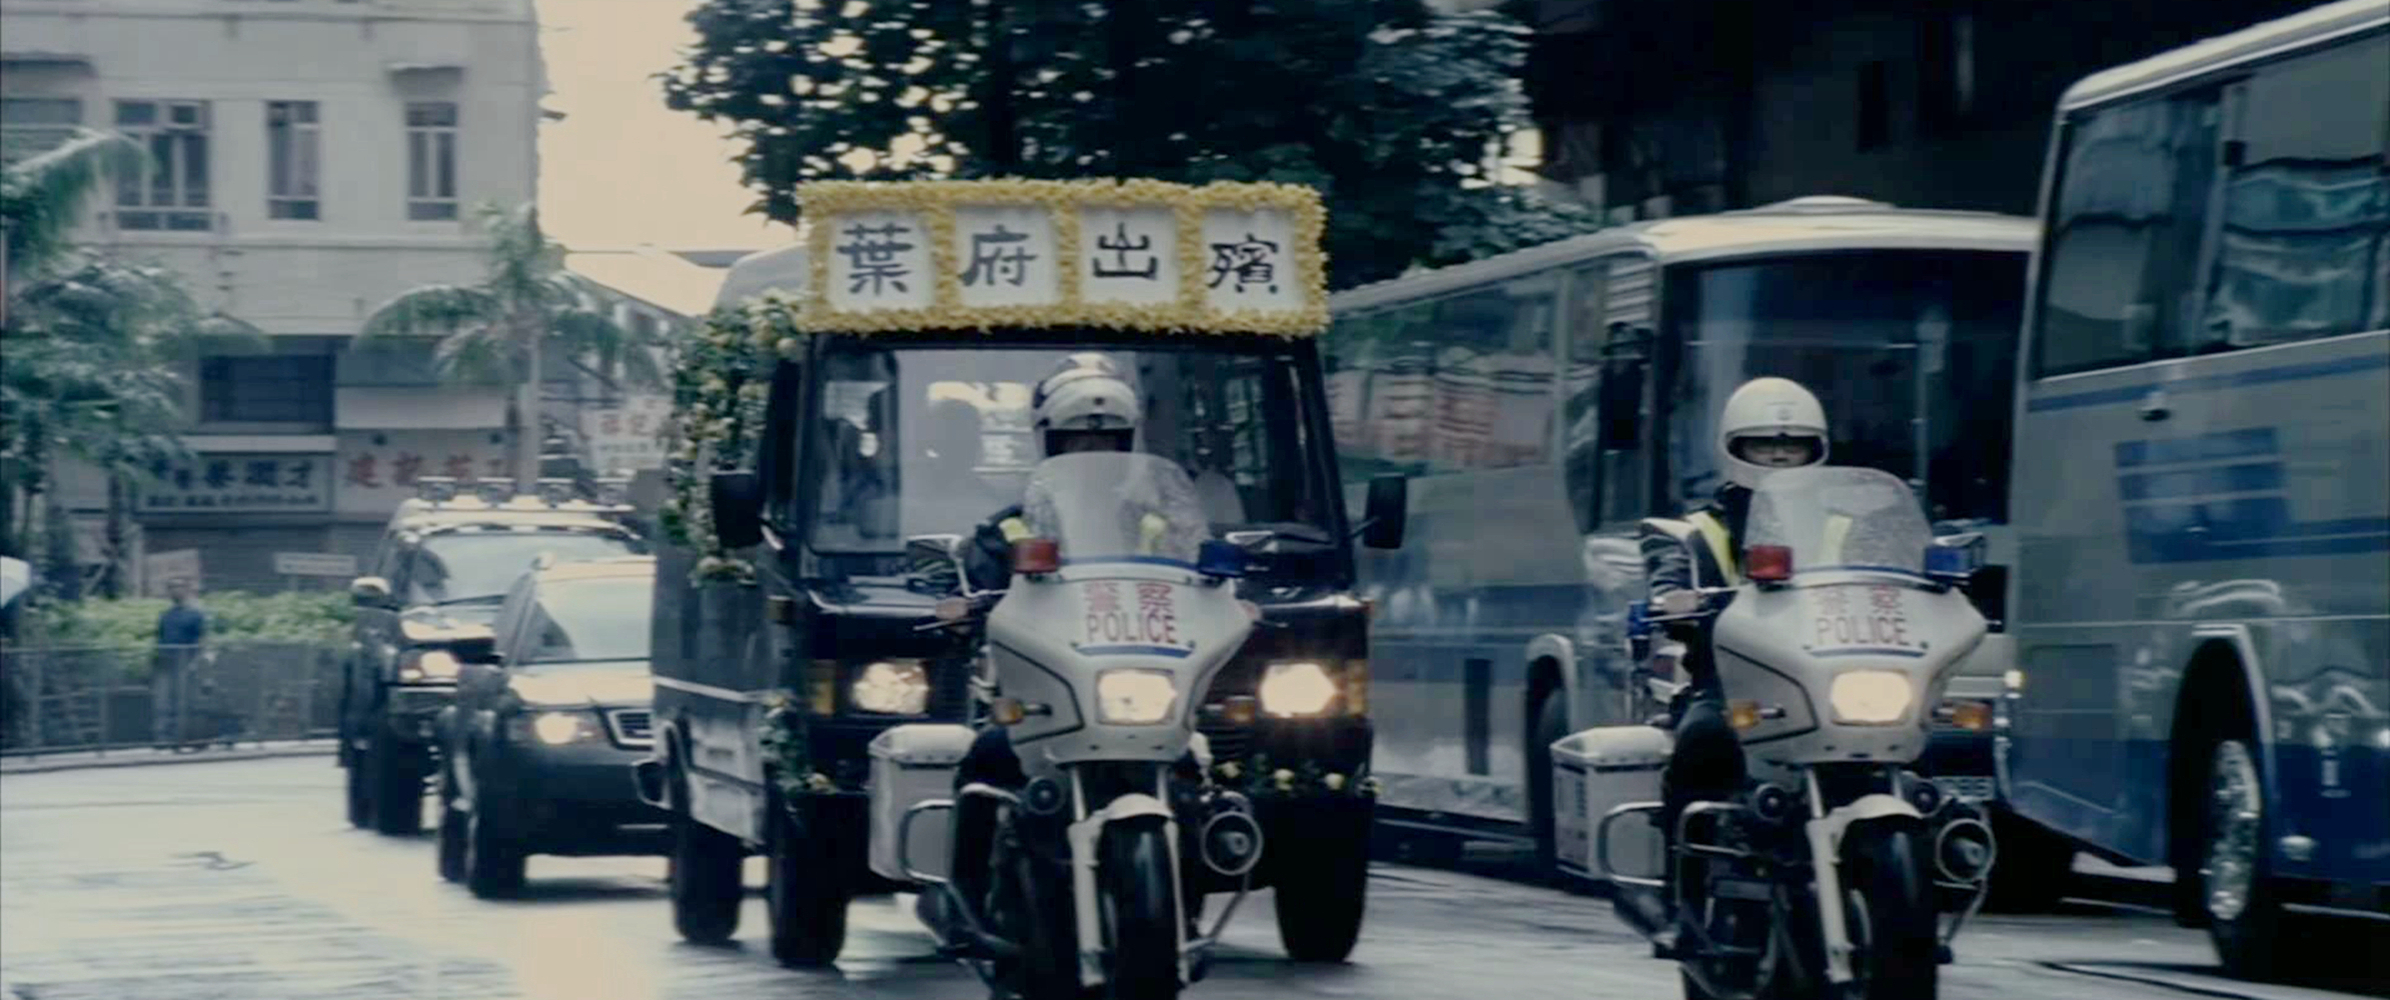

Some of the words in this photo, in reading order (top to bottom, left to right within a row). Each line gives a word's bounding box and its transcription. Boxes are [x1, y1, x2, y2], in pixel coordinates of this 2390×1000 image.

[837, 222, 1279, 296] 葉府出殯
[1086, 612, 1177, 644] POLICE
[1816, 616, 1909, 645] POLICE
